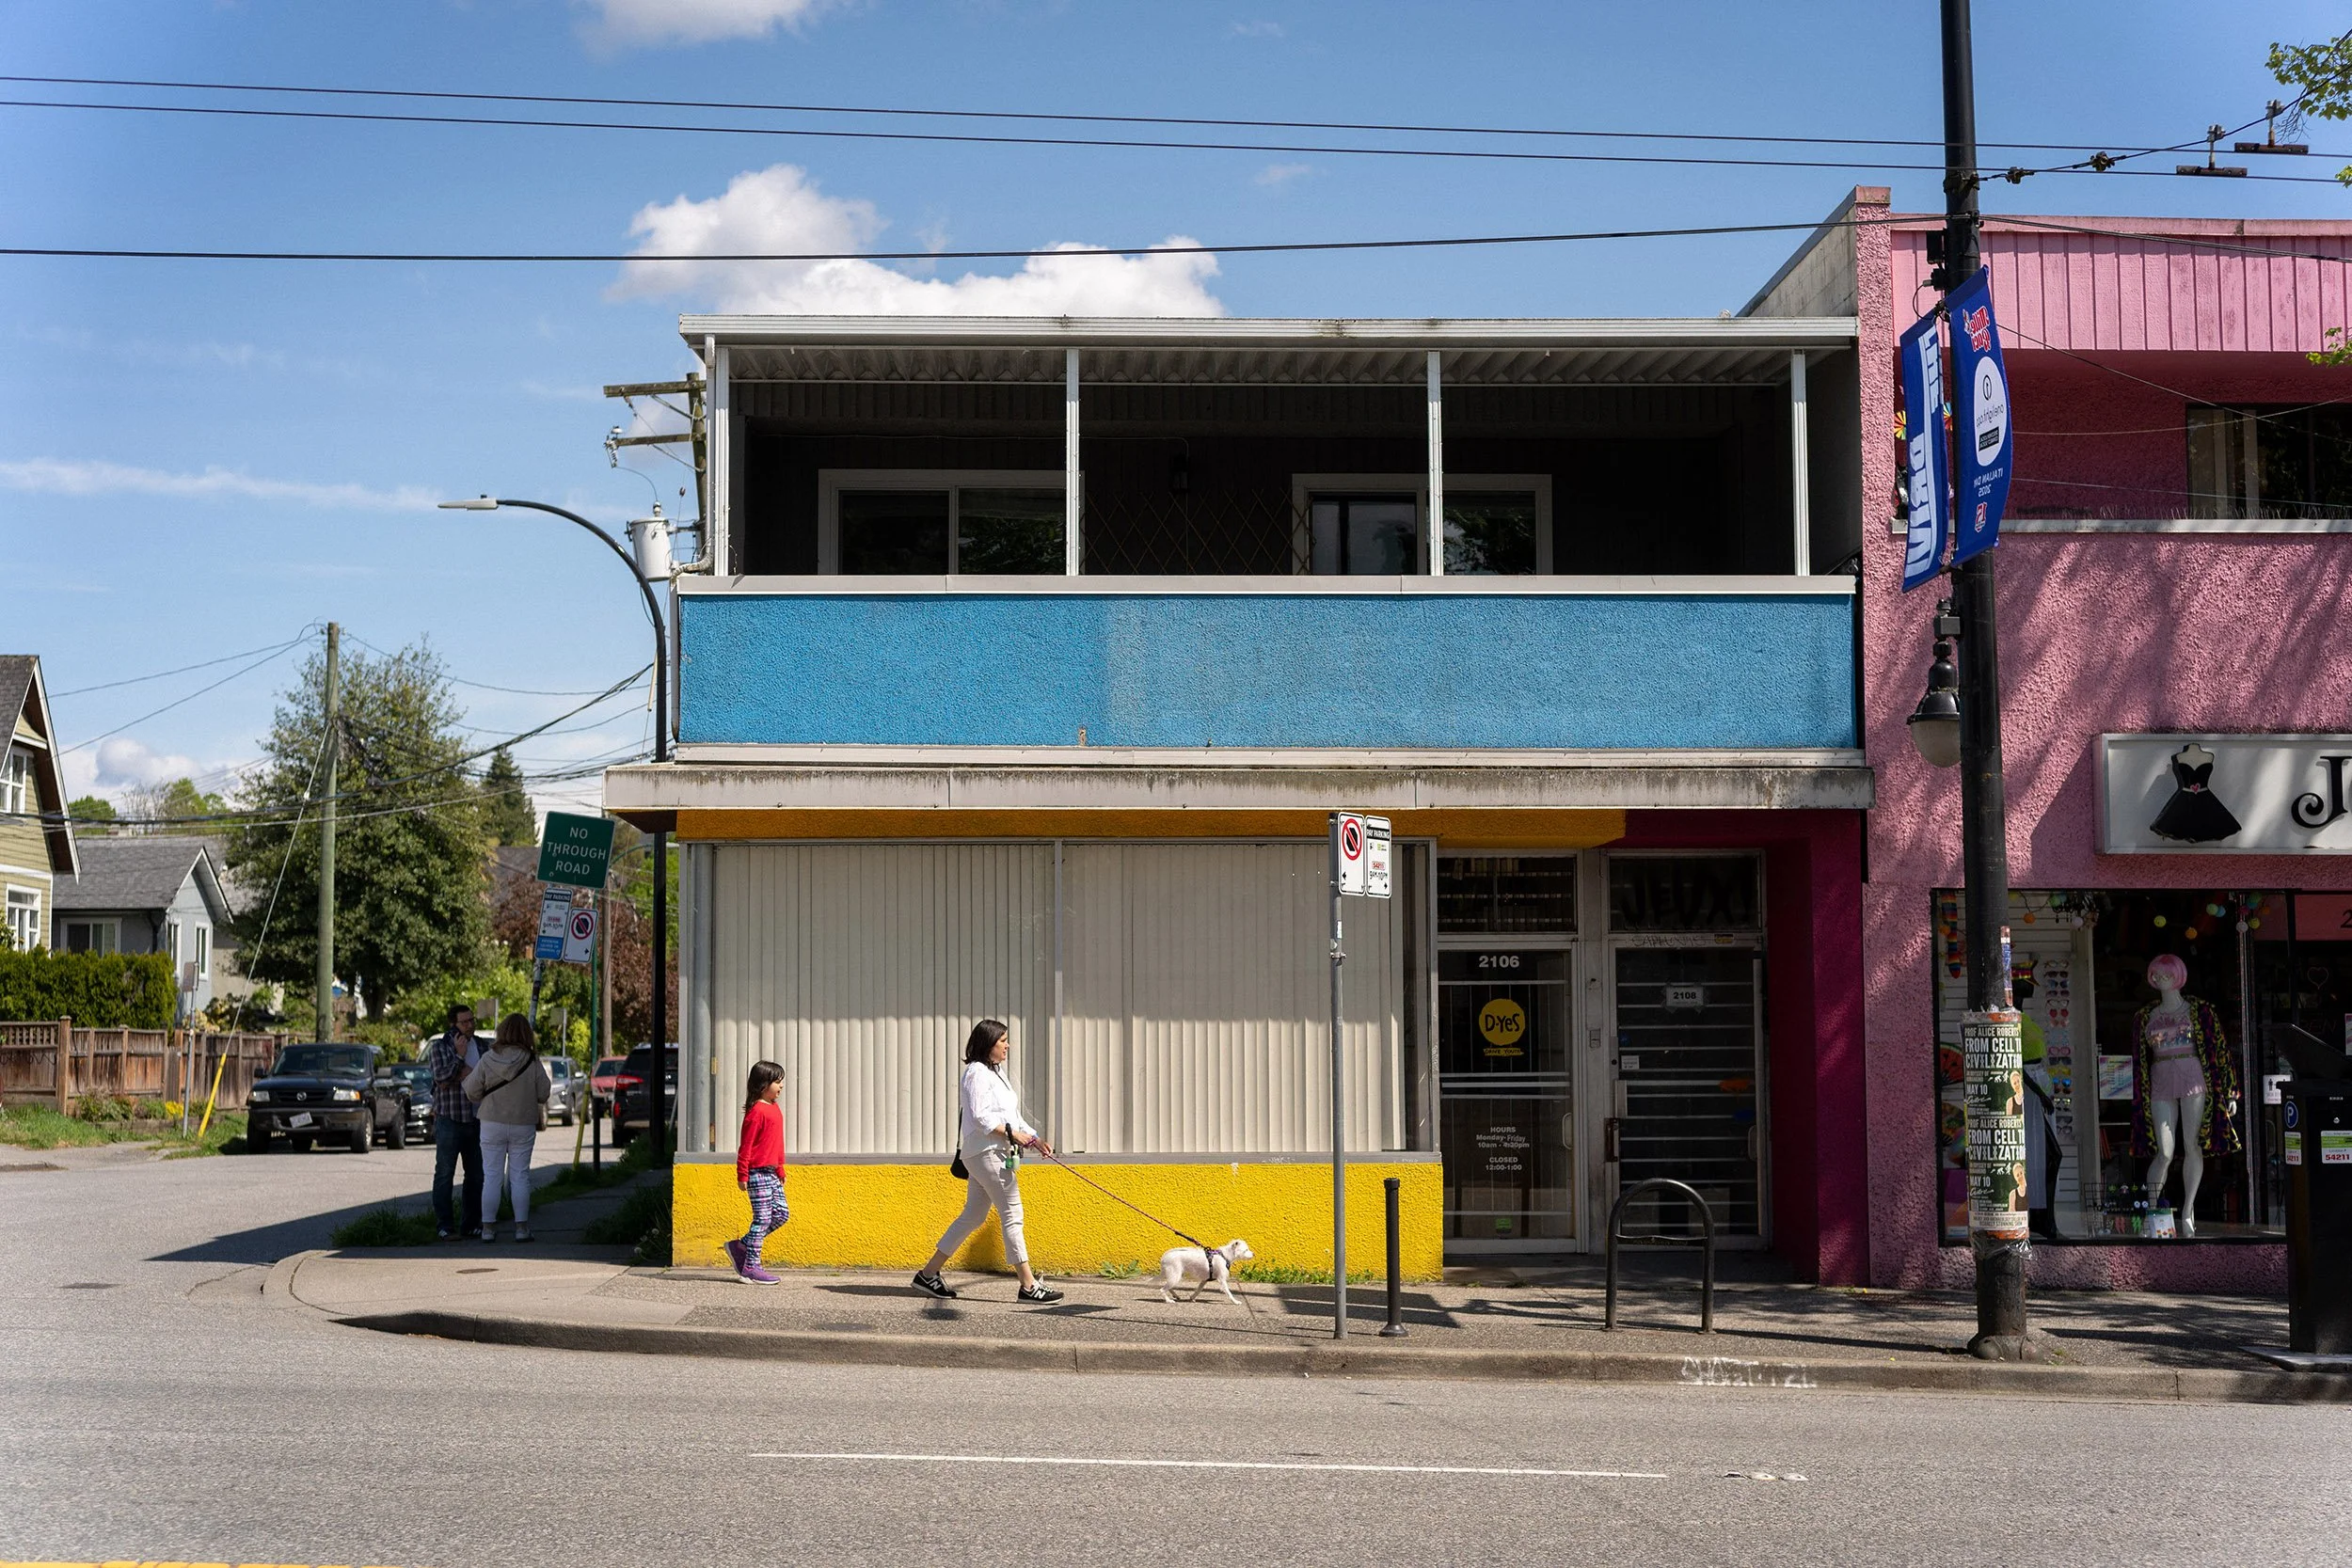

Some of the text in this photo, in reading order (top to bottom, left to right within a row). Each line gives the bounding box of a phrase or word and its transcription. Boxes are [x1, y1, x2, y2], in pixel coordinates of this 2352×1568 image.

[569, 827, 588, 840] NO
[1374, 830, 1390, 839] PARKING
[547, 842, 607, 860] THROUGH
[555, 861, 591, 876] ROAD
[1479, 955, 1520, 968] 2106
[1673, 991, 1696, 1000] 2108
[1964, 1027, 2019, 1037] PROF ALICE ROBERTS
[1964, 1037, 1989, 1053] FROM
[1992, 1037, 2014, 1053] CELL
[1967, 1084, 1988, 1095] MAY 10
[1968, 1119, 2021, 1128] PROF ALICE ROBERTS
[1507, 1134, 1526, 1143] Friday
[1968, 1130, 1991, 1144] FROM
[1994, 1130, 2017, 1145] CELL
[1970, 1176, 1991, 1187] MAY 10
[930, 1280, 942, 1291] N
[1033, 1290, 1046, 1300] N
